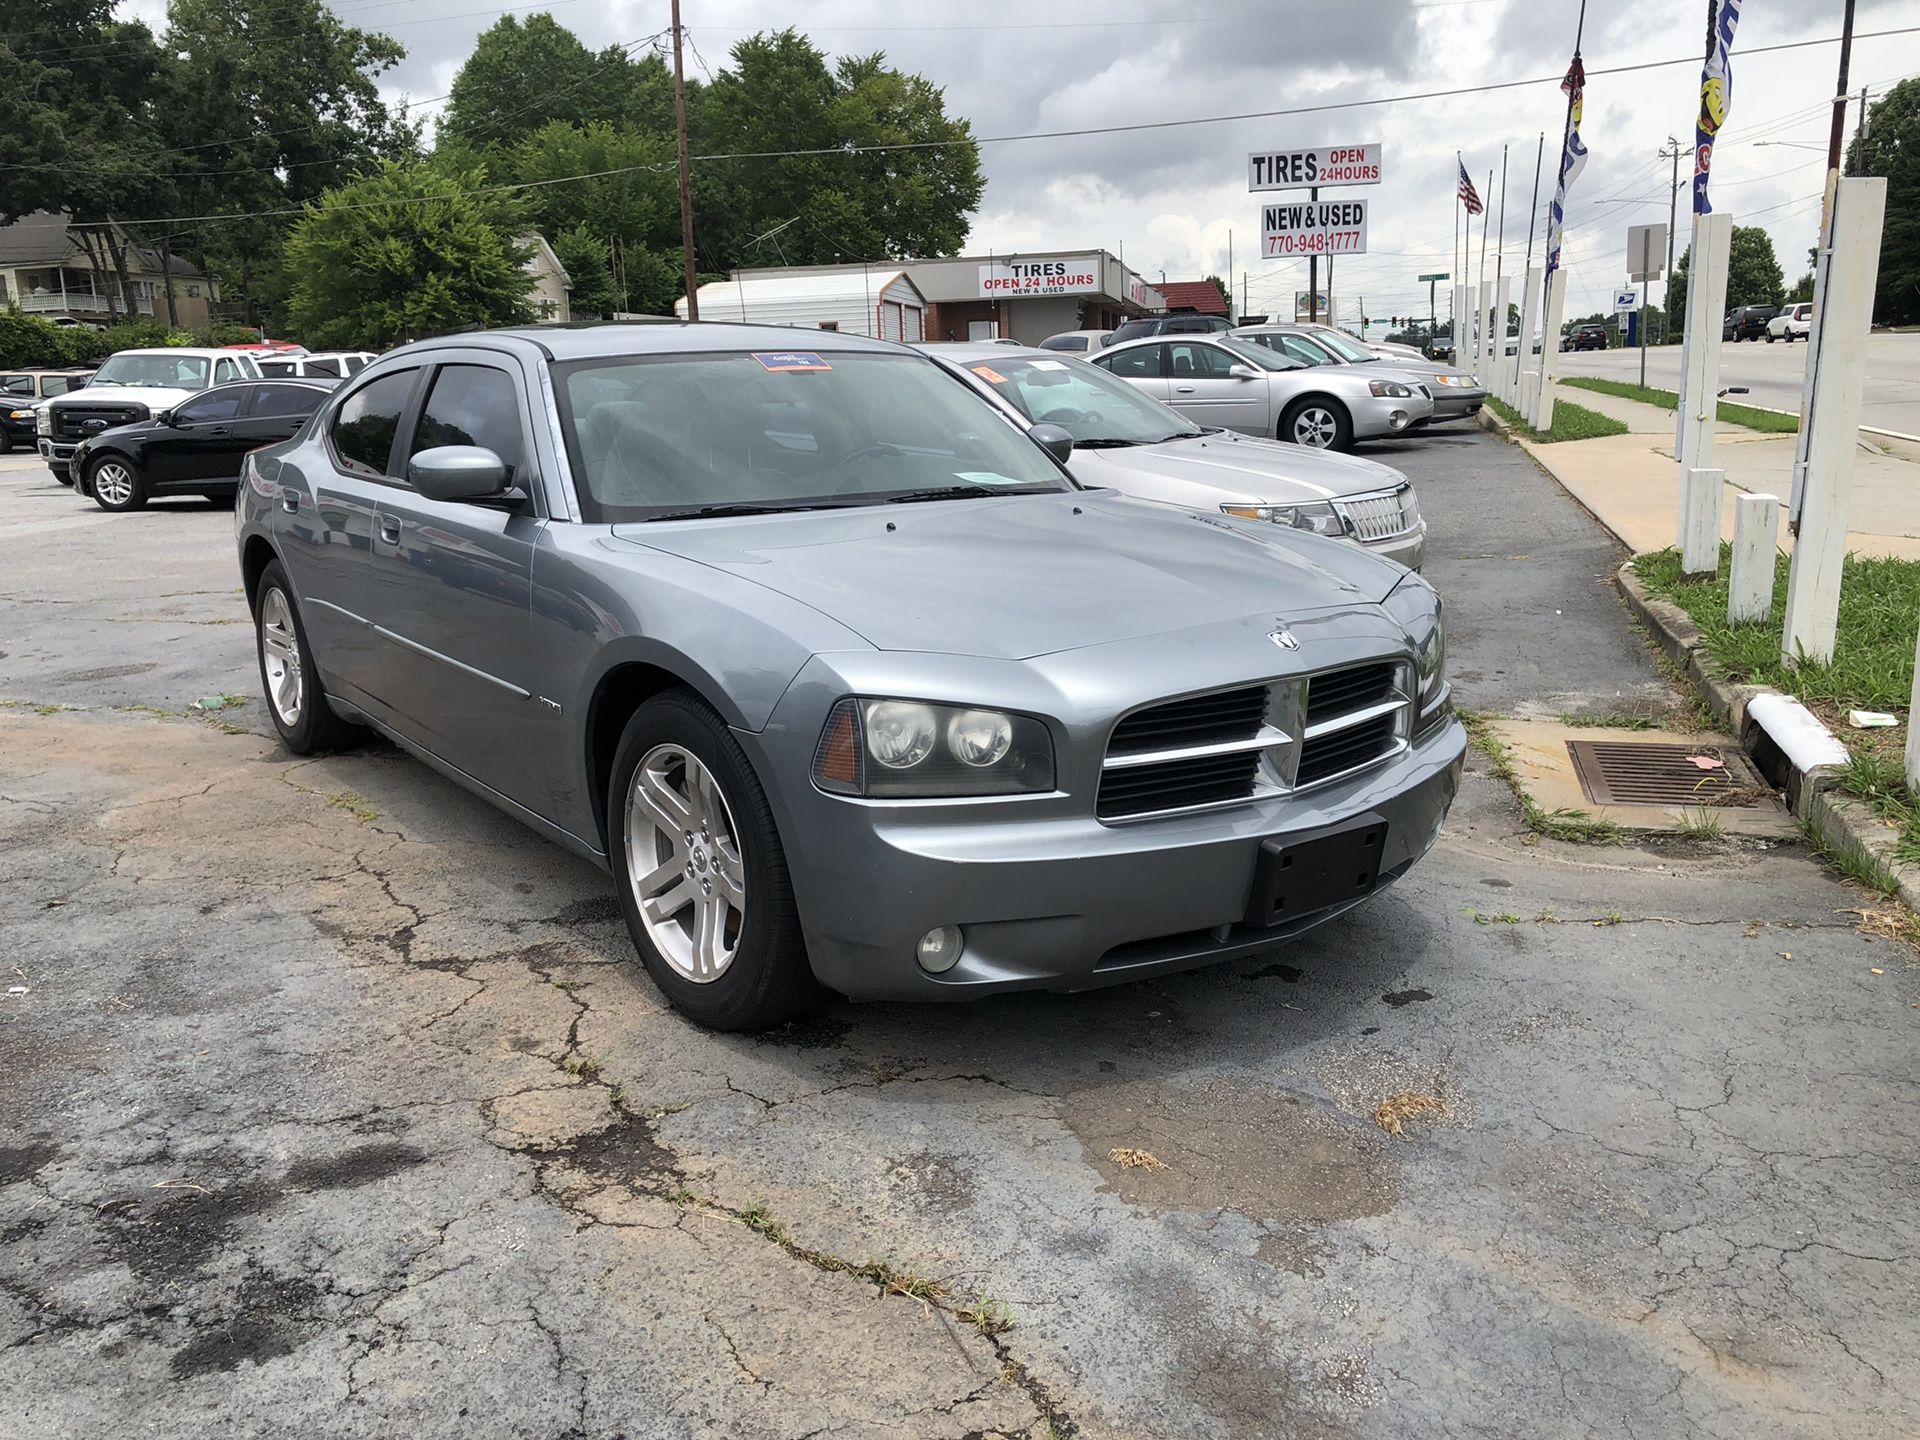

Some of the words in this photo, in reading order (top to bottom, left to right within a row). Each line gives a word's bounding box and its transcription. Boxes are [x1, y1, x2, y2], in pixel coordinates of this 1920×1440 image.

[1330, 149, 1365, 164] OPEN
[1252, 153, 1318, 185] TIRES
[1011, 262, 1066, 278] TIRES
[984, 278, 1020, 290] OPEN
[1025, 277, 1040, 288] 24
[1047, 274, 1094, 287] HOURS
[1042, 286, 1065, 294] USED
